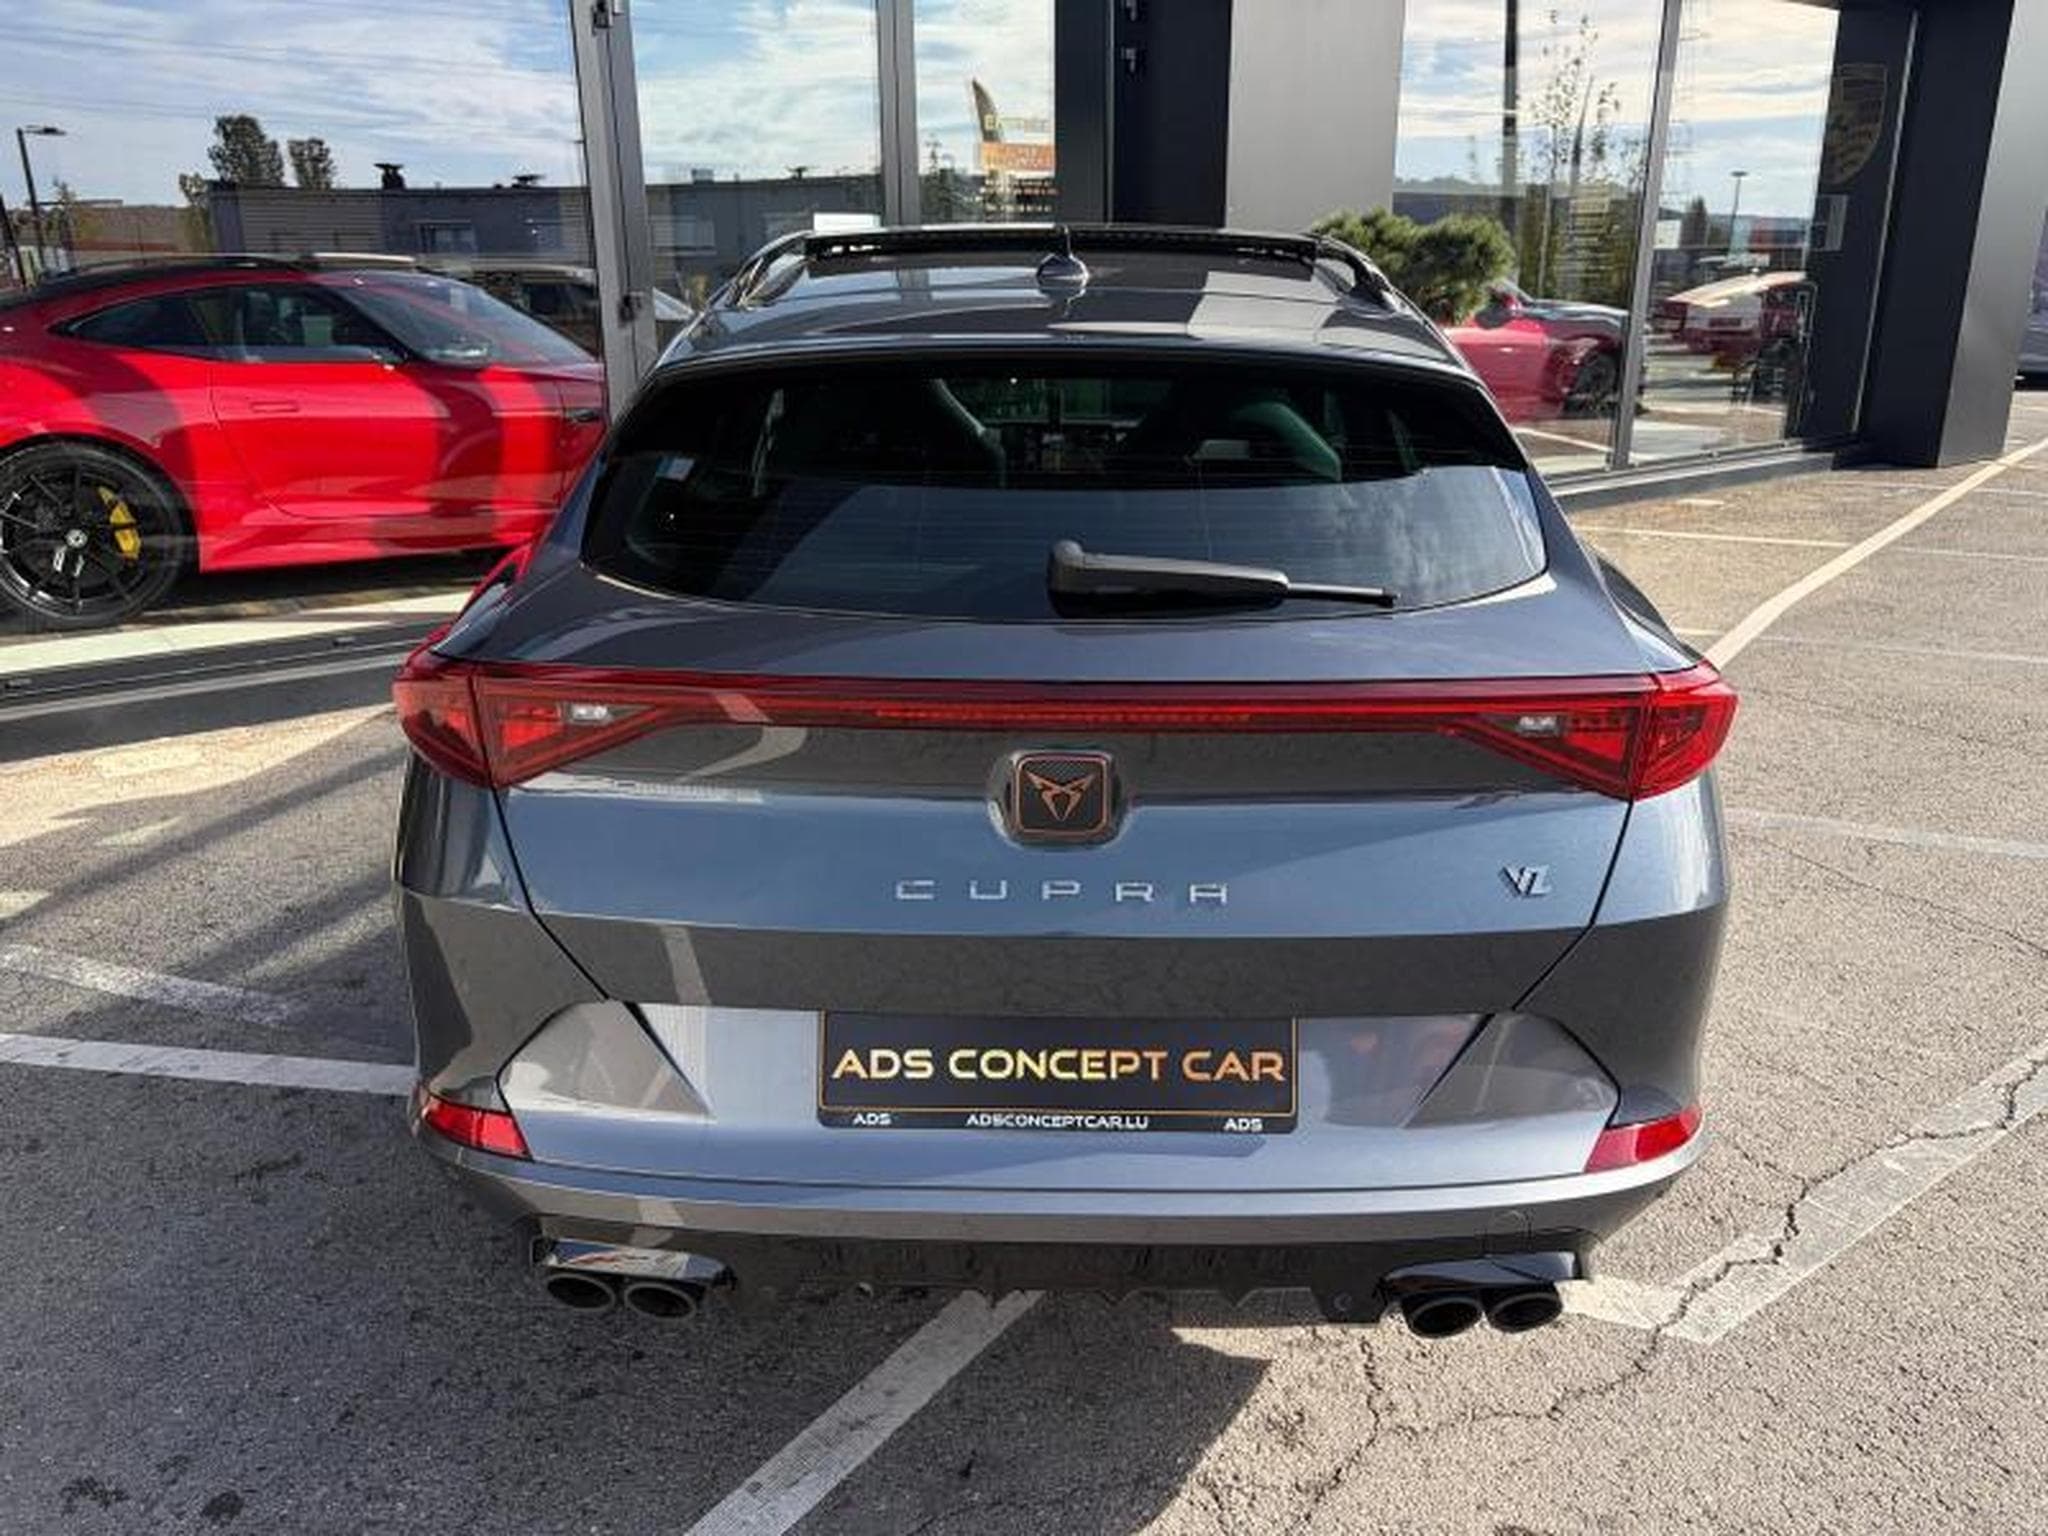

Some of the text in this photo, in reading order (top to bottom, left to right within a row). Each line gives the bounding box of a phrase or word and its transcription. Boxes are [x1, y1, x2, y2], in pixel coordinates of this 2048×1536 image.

[895, 879, 1230, 905] CUPRA
[832, 1048, 1286, 1082] ADS CONCEPT CAR
[853, 1113, 891, 1126] ADS
[1224, 1118, 1263, 1133] ADS
